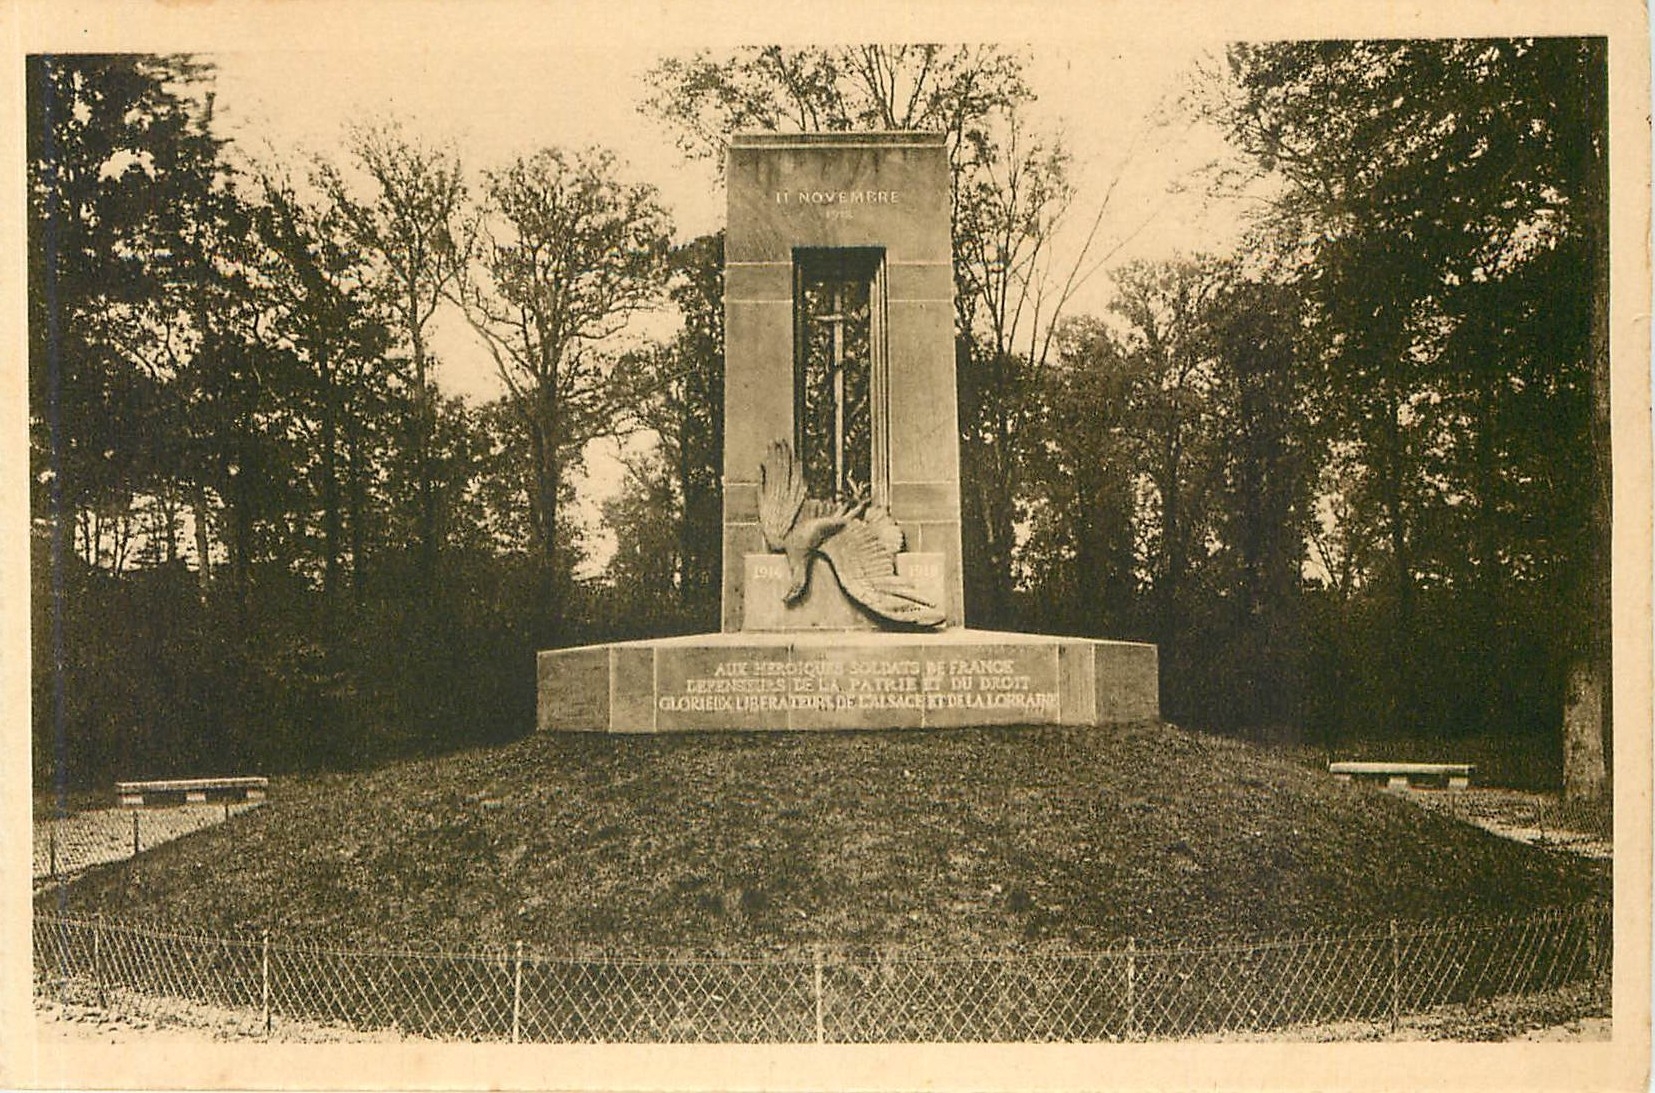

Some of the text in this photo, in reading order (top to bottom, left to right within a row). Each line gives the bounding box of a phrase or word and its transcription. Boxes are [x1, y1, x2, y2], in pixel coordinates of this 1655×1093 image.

[799, 191, 900, 204] NOVEMBRE
[714, 662, 749, 677] AUX
[849, 660, 920, 675] SOLDATS
[926, 661, 946, 676] DE
[949, 660, 1015, 675] FRANCE
[793, 677, 815, 692] DE
[819, 677, 842, 692] LA
[850, 677, 918, 692] PATRIE
[923, 676, 941, 691] ET
[951, 676, 973, 690] DU
[979, 676, 1032, 691] DROIT
[658, 696, 732, 712] GLORIEUX
[837, 695, 855, 709] DE
[927, 694, 944, 709] ET
[947, 693, 965, 708] DE
[966, 693, 985, 709] LA
